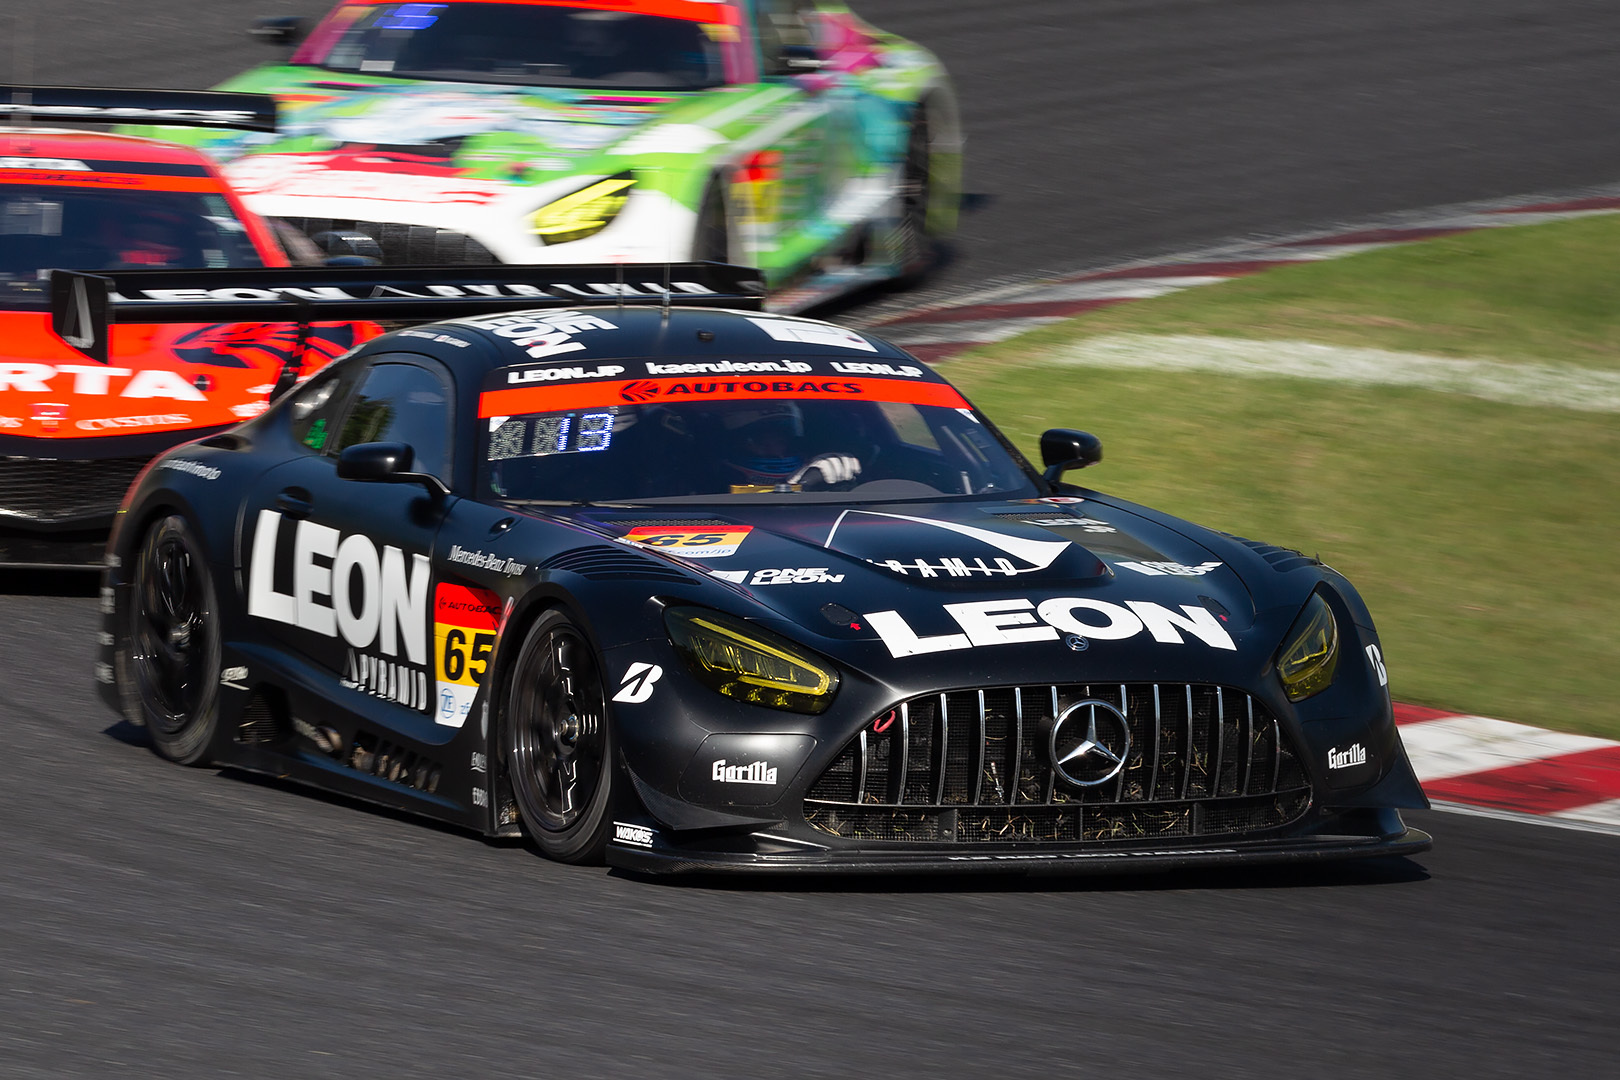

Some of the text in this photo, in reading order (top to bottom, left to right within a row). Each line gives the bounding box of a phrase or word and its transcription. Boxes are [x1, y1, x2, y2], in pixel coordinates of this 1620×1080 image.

[507, 365, 625, 384] LEON.JP
[645, 359, 813, 376] kaeruleon.jp
[665, 381, 864, 395] AUTOBACS
[640, 533, 725, 546] 65
[447, 545, 506, 572] Mercedes-Benz
[866, 557, 1019, 578] RAMID
[750, 574, 845, 586] LEON
[753, 567, 829, 578] ONE
[248, 509, 430, 665] LEON
[448, 602, 502, 615] AUTOBAC
[863, 597, 1237, 658] LEON
[444, 629, 495, 686] 65
[1327, 743, 1366, 769] Gorilla
[712, 759, 777, 785] Gorilla
